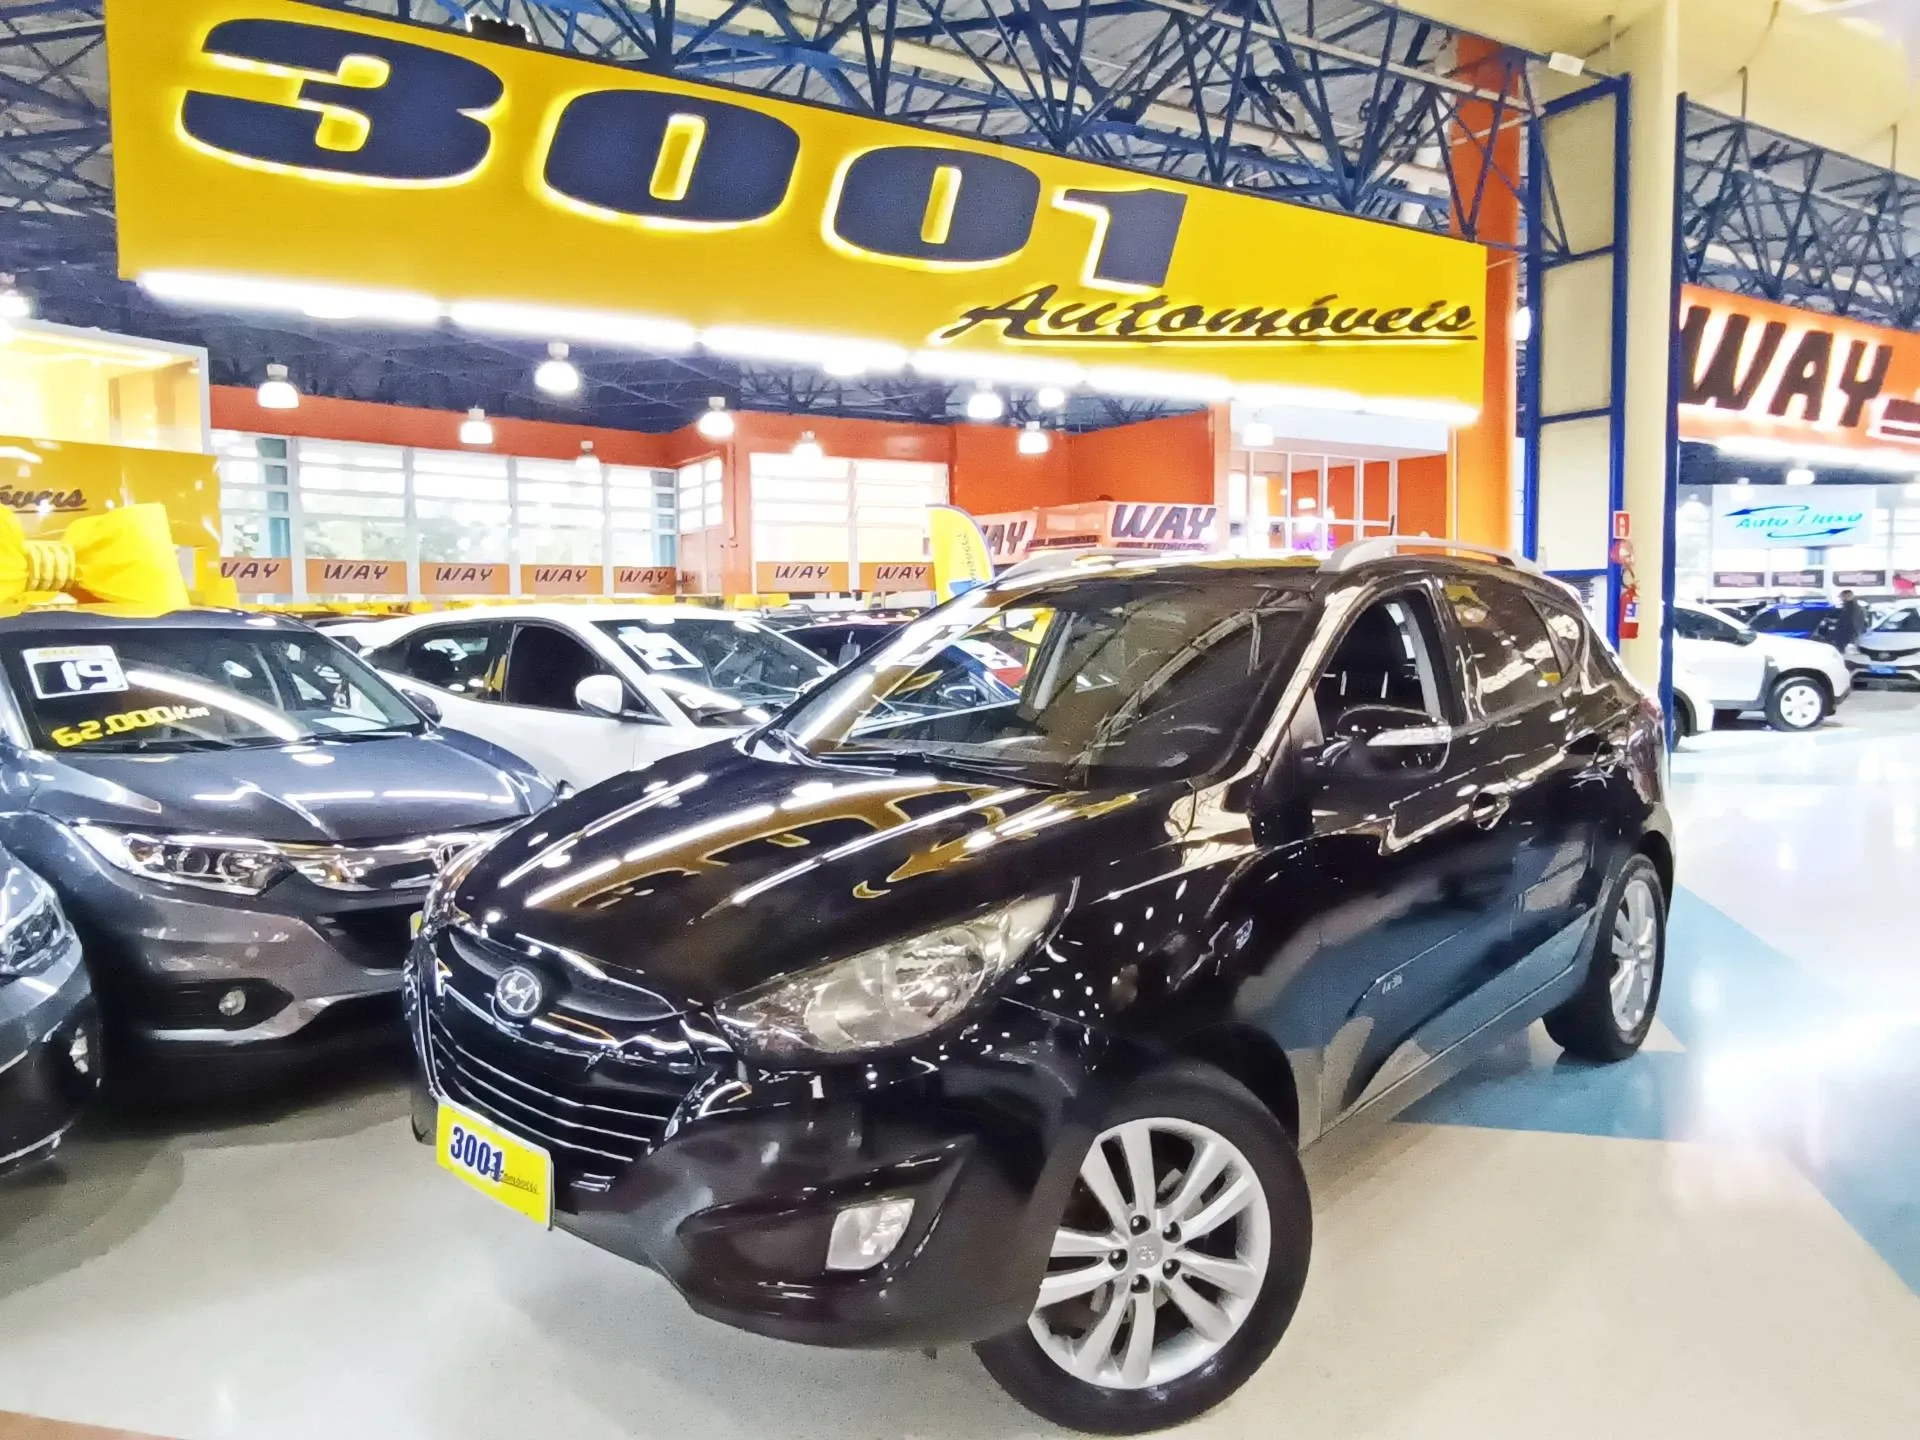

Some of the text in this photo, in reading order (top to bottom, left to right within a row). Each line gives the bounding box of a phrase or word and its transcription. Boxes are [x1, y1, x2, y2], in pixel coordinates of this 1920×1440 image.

[181, 18, 1187, 288] 3001
[941, 284, 1477, 342] Automóveis
[1679, 304, 1893, 427] WAY
[1111, 504, 1217, 540] WAY
[323, 564, 389, 580] WAY
[435, 567, 493, 582] WAY
[534, 568, 588, 583] WAY
[619, 569, 669, 583] WAY
[775, 563, 829, 580] WAY
[876, 563, 928, 580] WAY
[450, 1125, 503, 1182] 3001
